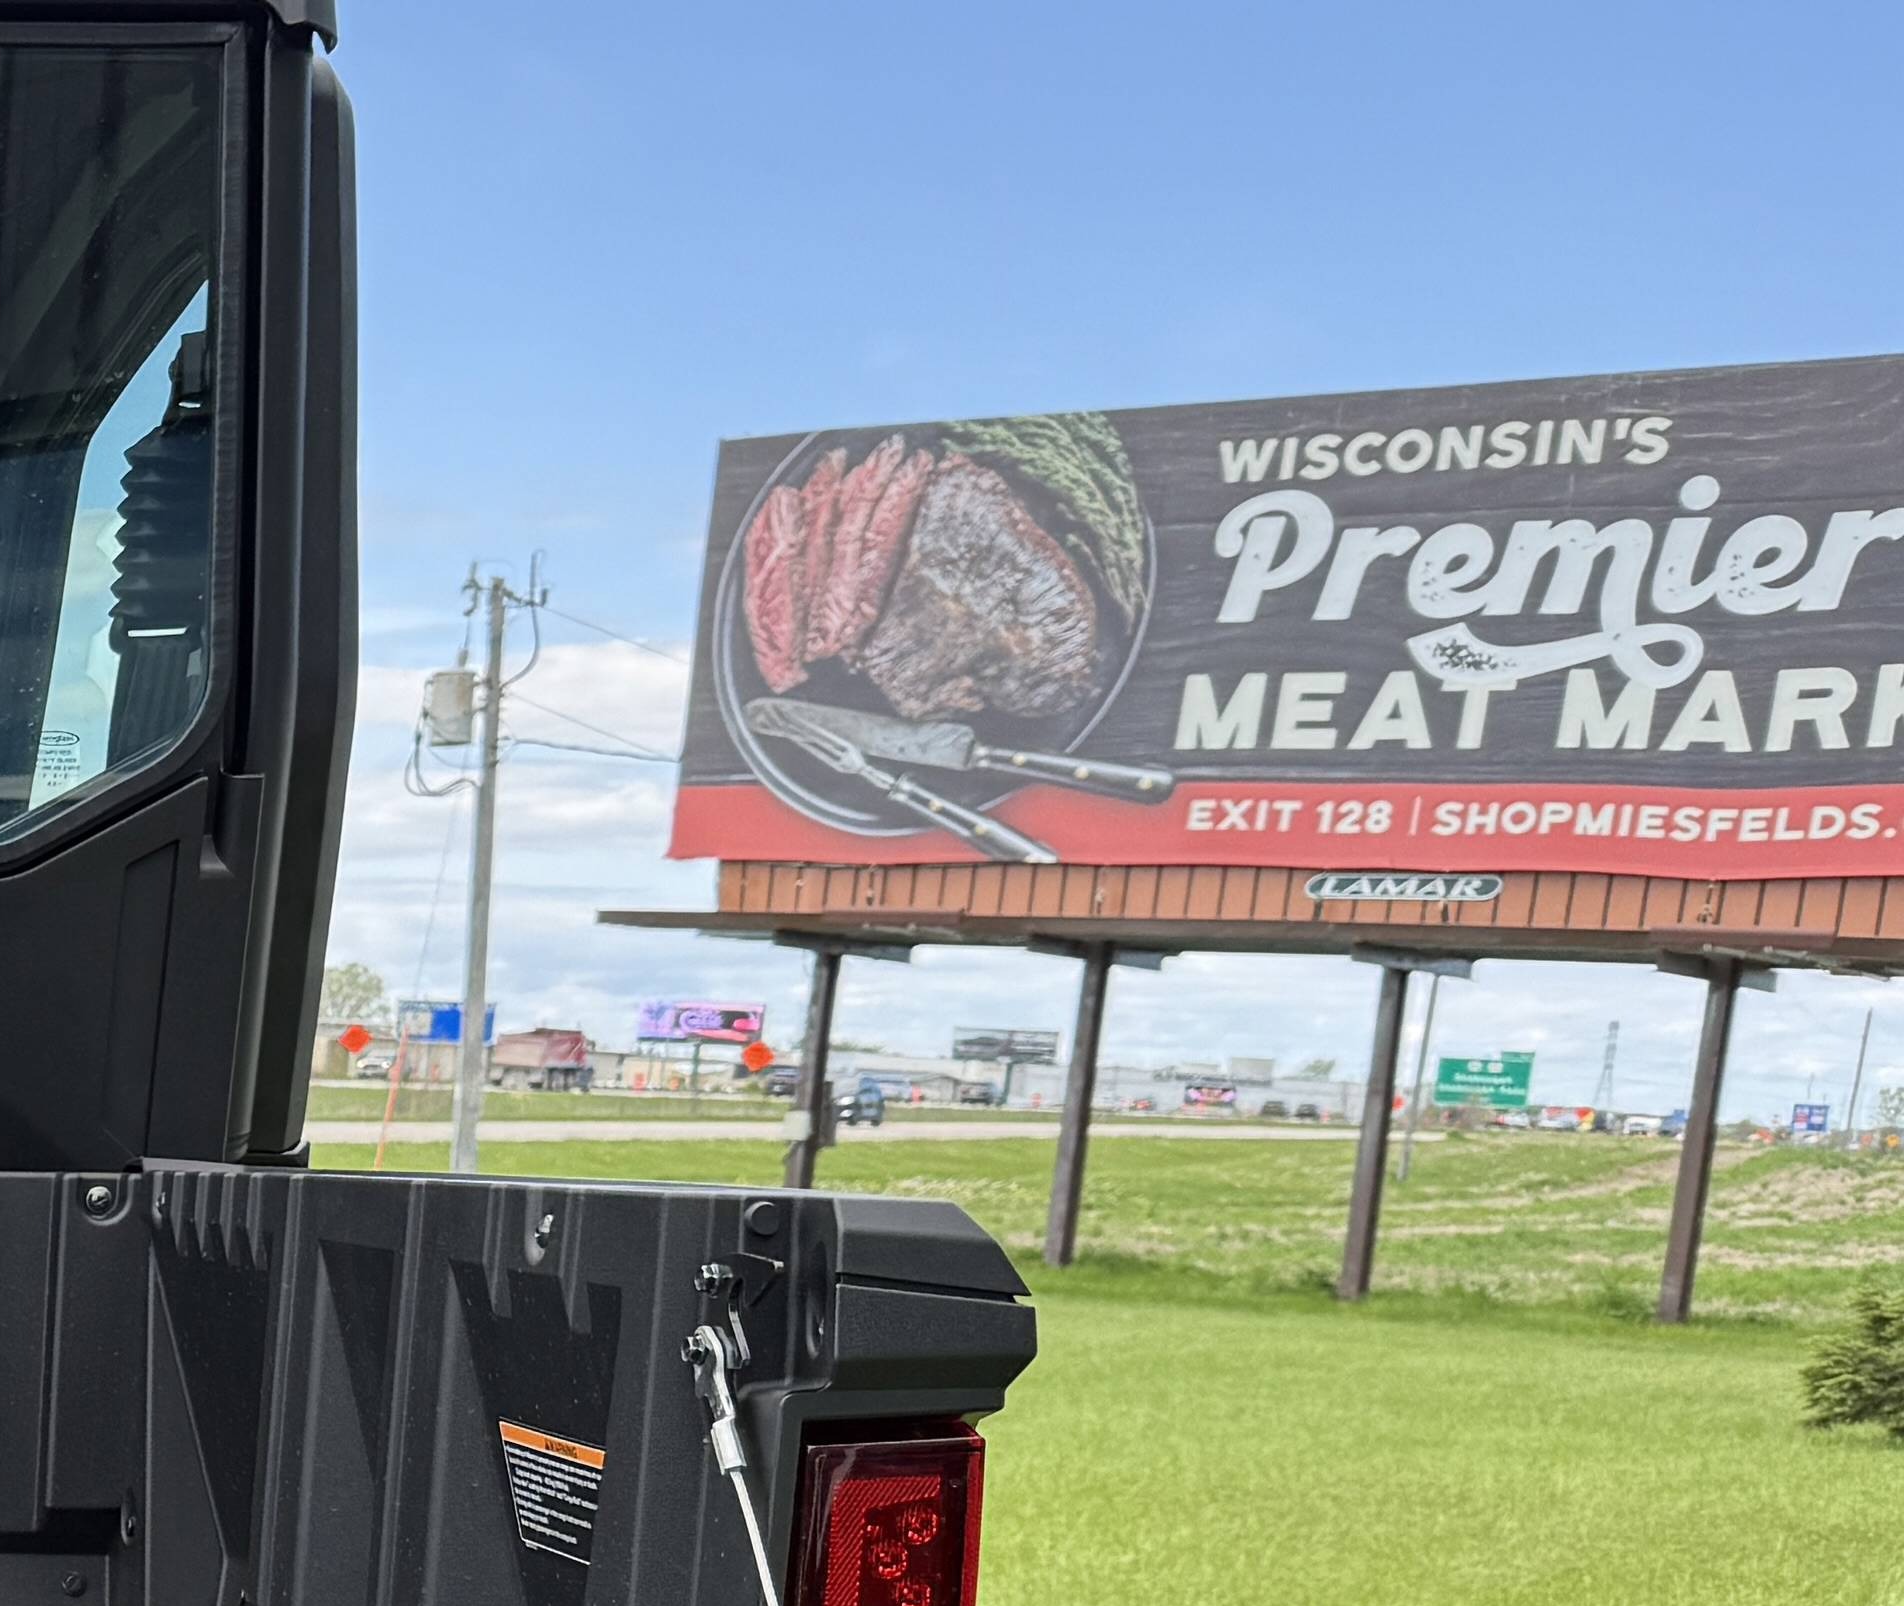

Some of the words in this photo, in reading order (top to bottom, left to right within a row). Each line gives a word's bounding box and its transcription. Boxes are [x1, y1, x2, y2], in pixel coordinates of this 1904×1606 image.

[1218, 416, 1674, 484] WISCONSIN'S
[1214, 474, 1904, 689] Premier
[1174, 670, 1518, 751] MEAT
[1185, 798, 1303, 831] EXIT
[1316, 799, 1394, 835] 128
[1319, 875, 1483, 898] LAMAR
